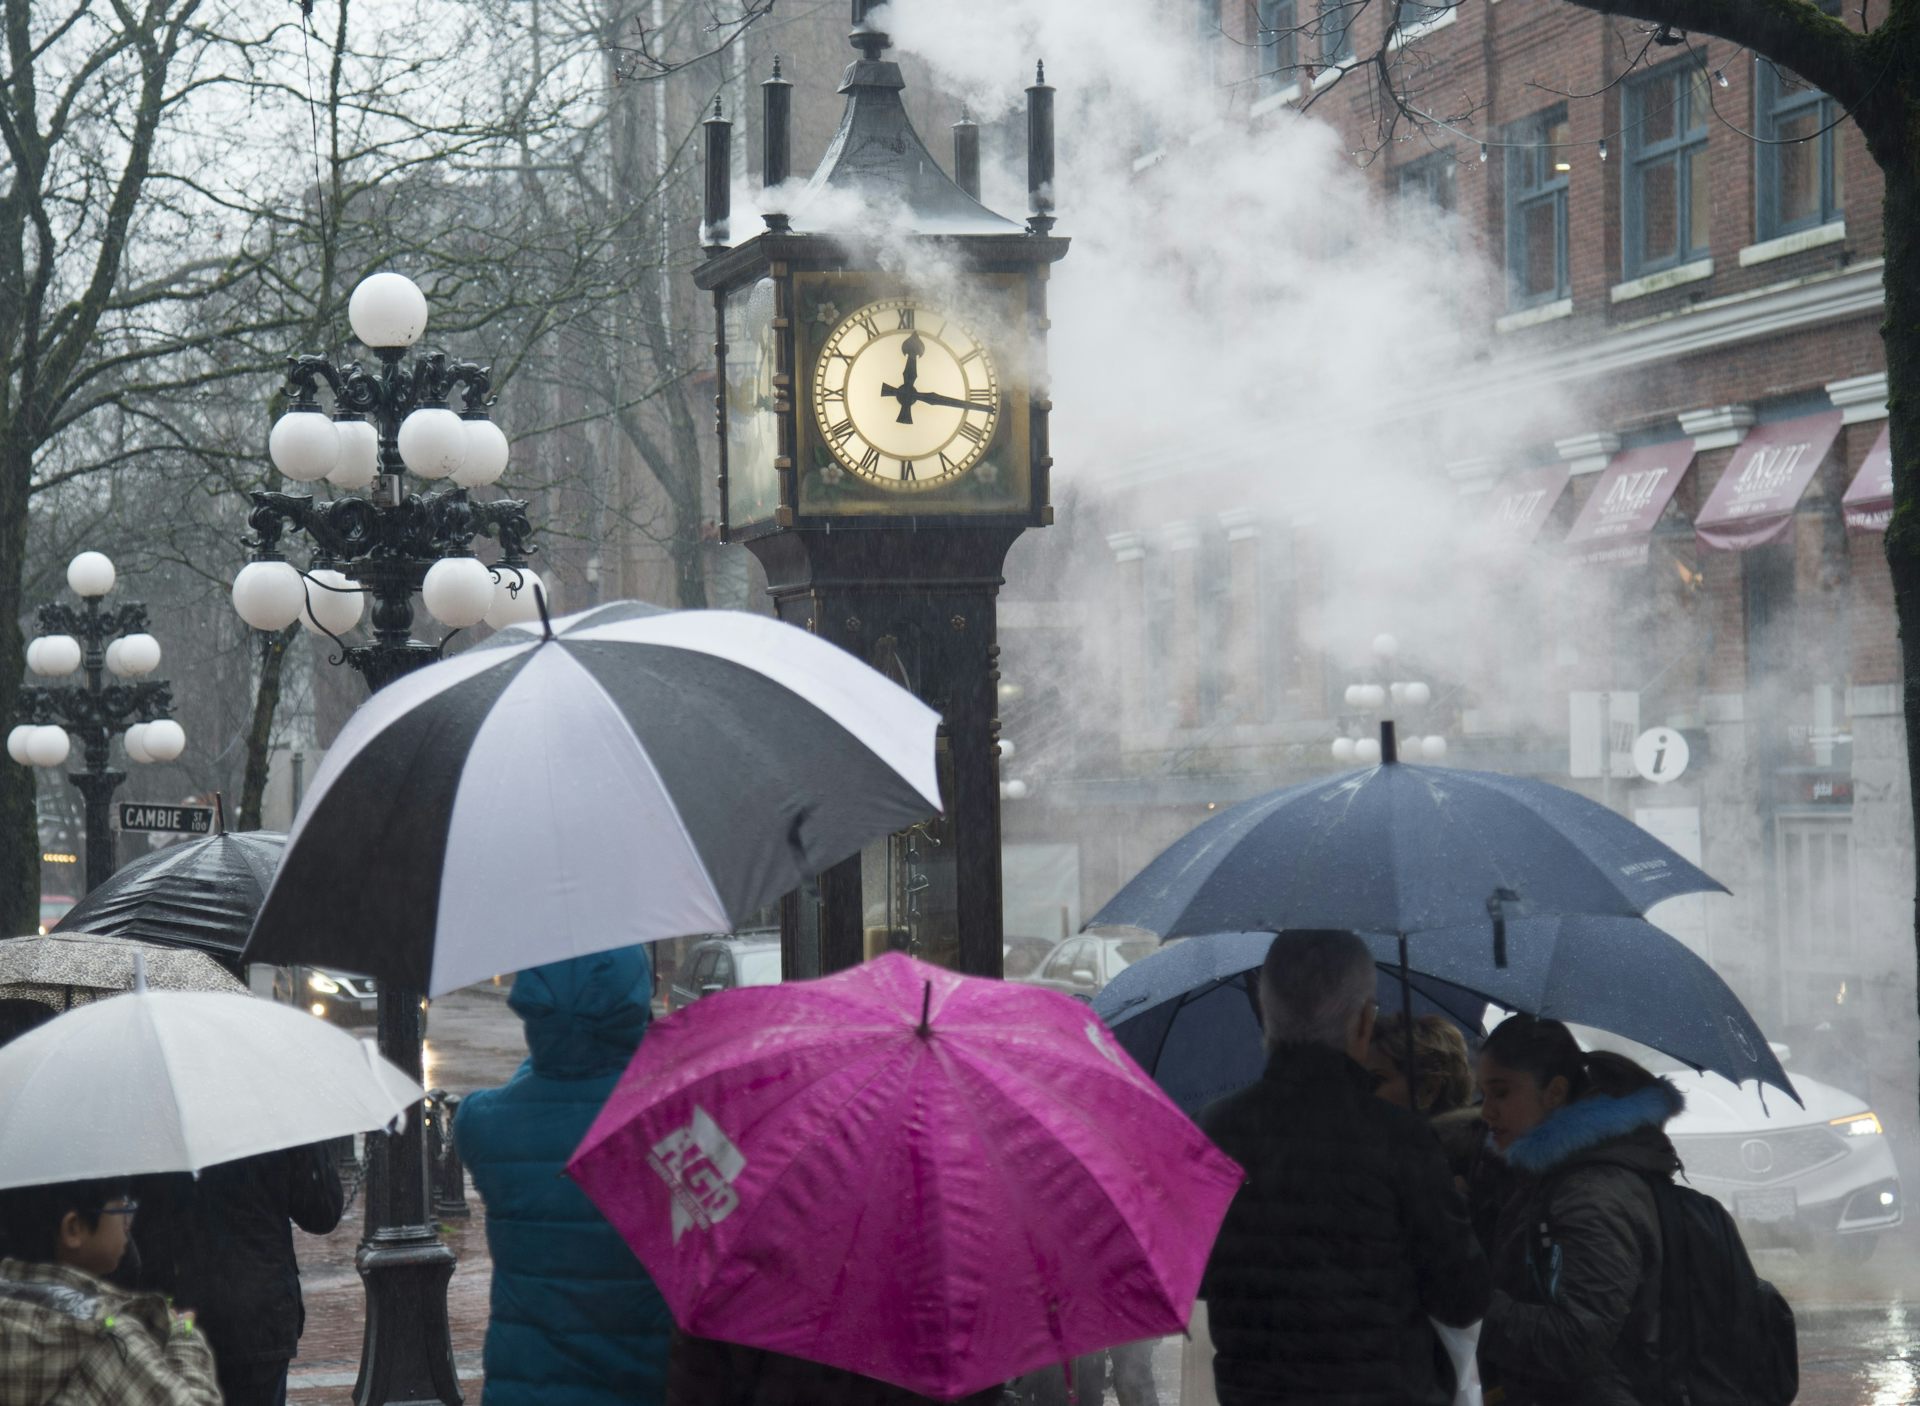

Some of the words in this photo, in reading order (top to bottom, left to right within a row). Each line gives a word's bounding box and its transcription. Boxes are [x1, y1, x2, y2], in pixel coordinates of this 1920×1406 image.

[859, 316, 880, 341] XI
[897, 308, 915, 330] XII
[831, 347, 854, 366] X
[822, 387, 845, 401] IX
[969, 388, 991, 401] III
[900, 459, 917, 481] VI
[125, 807, 182, 829] CAMBIE
[193, 811, 204, 822] ST
[191, 821, 207, 831] 100
